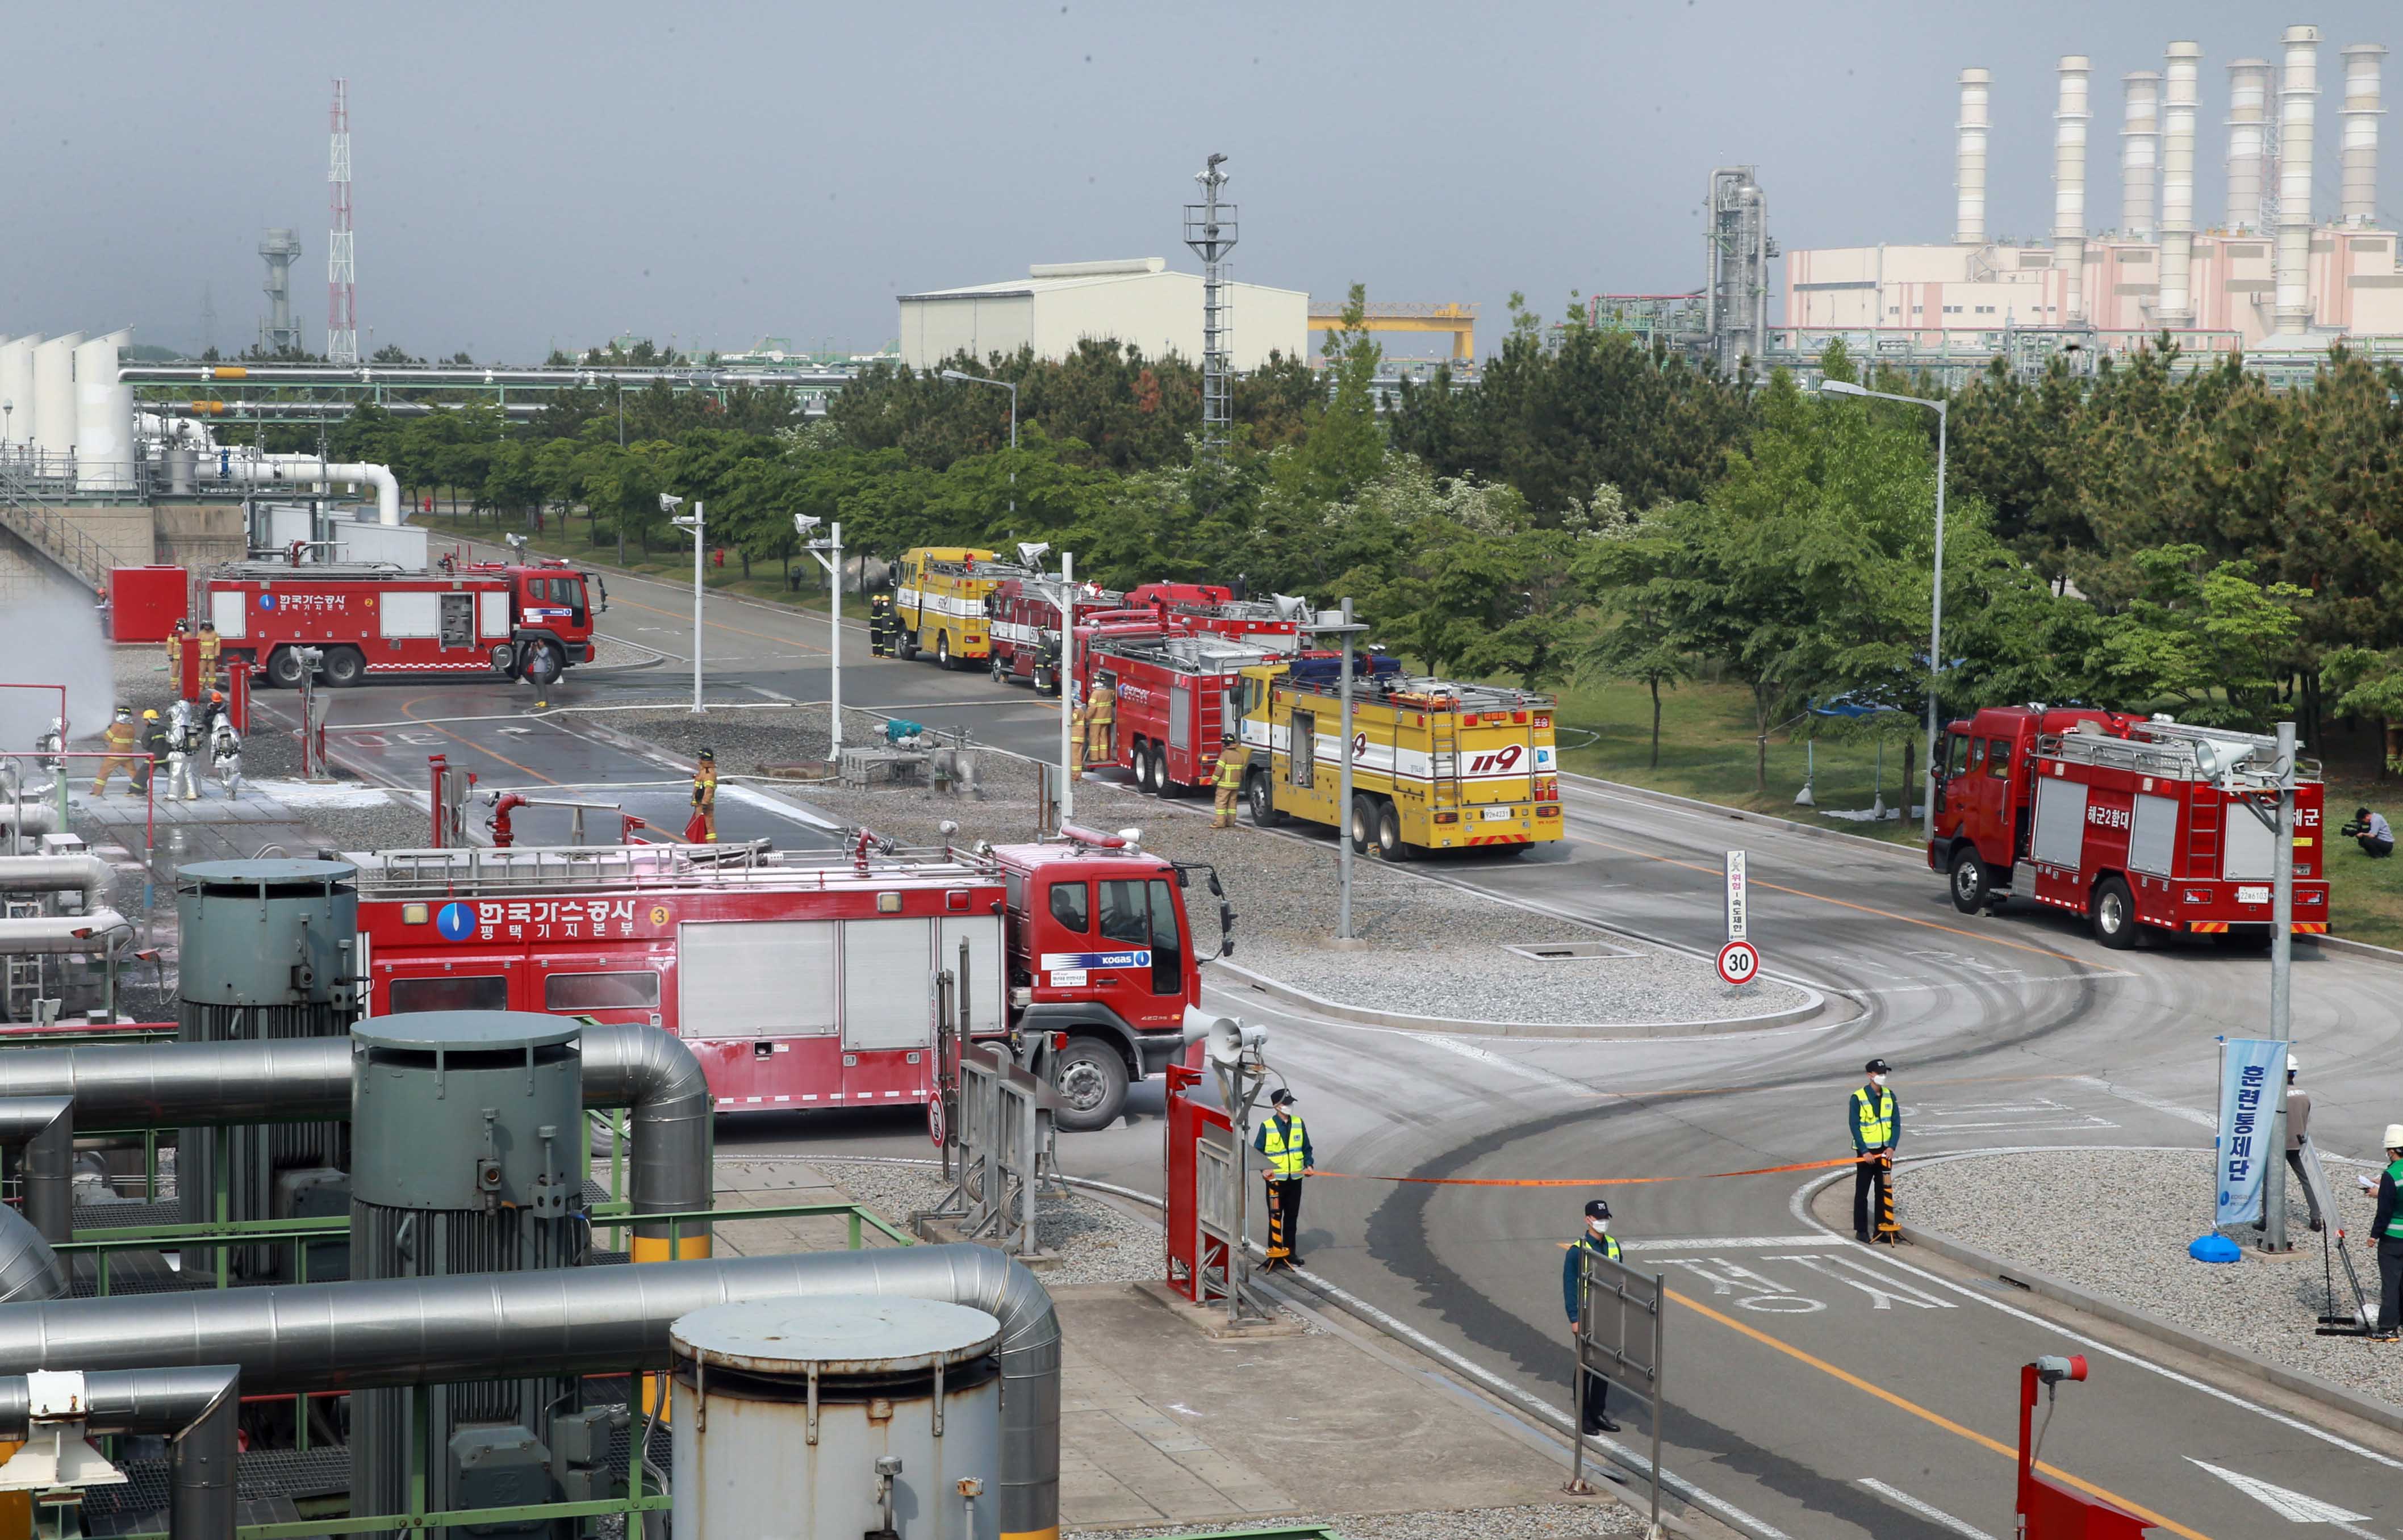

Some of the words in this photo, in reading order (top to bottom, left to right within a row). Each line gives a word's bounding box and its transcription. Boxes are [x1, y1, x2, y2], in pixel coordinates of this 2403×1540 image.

[279, 595, 345, 604] 한국가스공사
[1534, 718, 1548, 727] 포승
[1469, 746, 1522, 774] 119
[2088, 806, 2130, 830] 해군2함대
[479, 900, 636, 924] 한국가스공사
[655, 909, 665, 923] 3
[480, 922, 633, 939] 평택기지본부
[1102, 956, 1132, 964] KOGAS
[1729, 954, 1748, 972] 30
[2229, 1065, 2264, 1182] 훈련통제단
